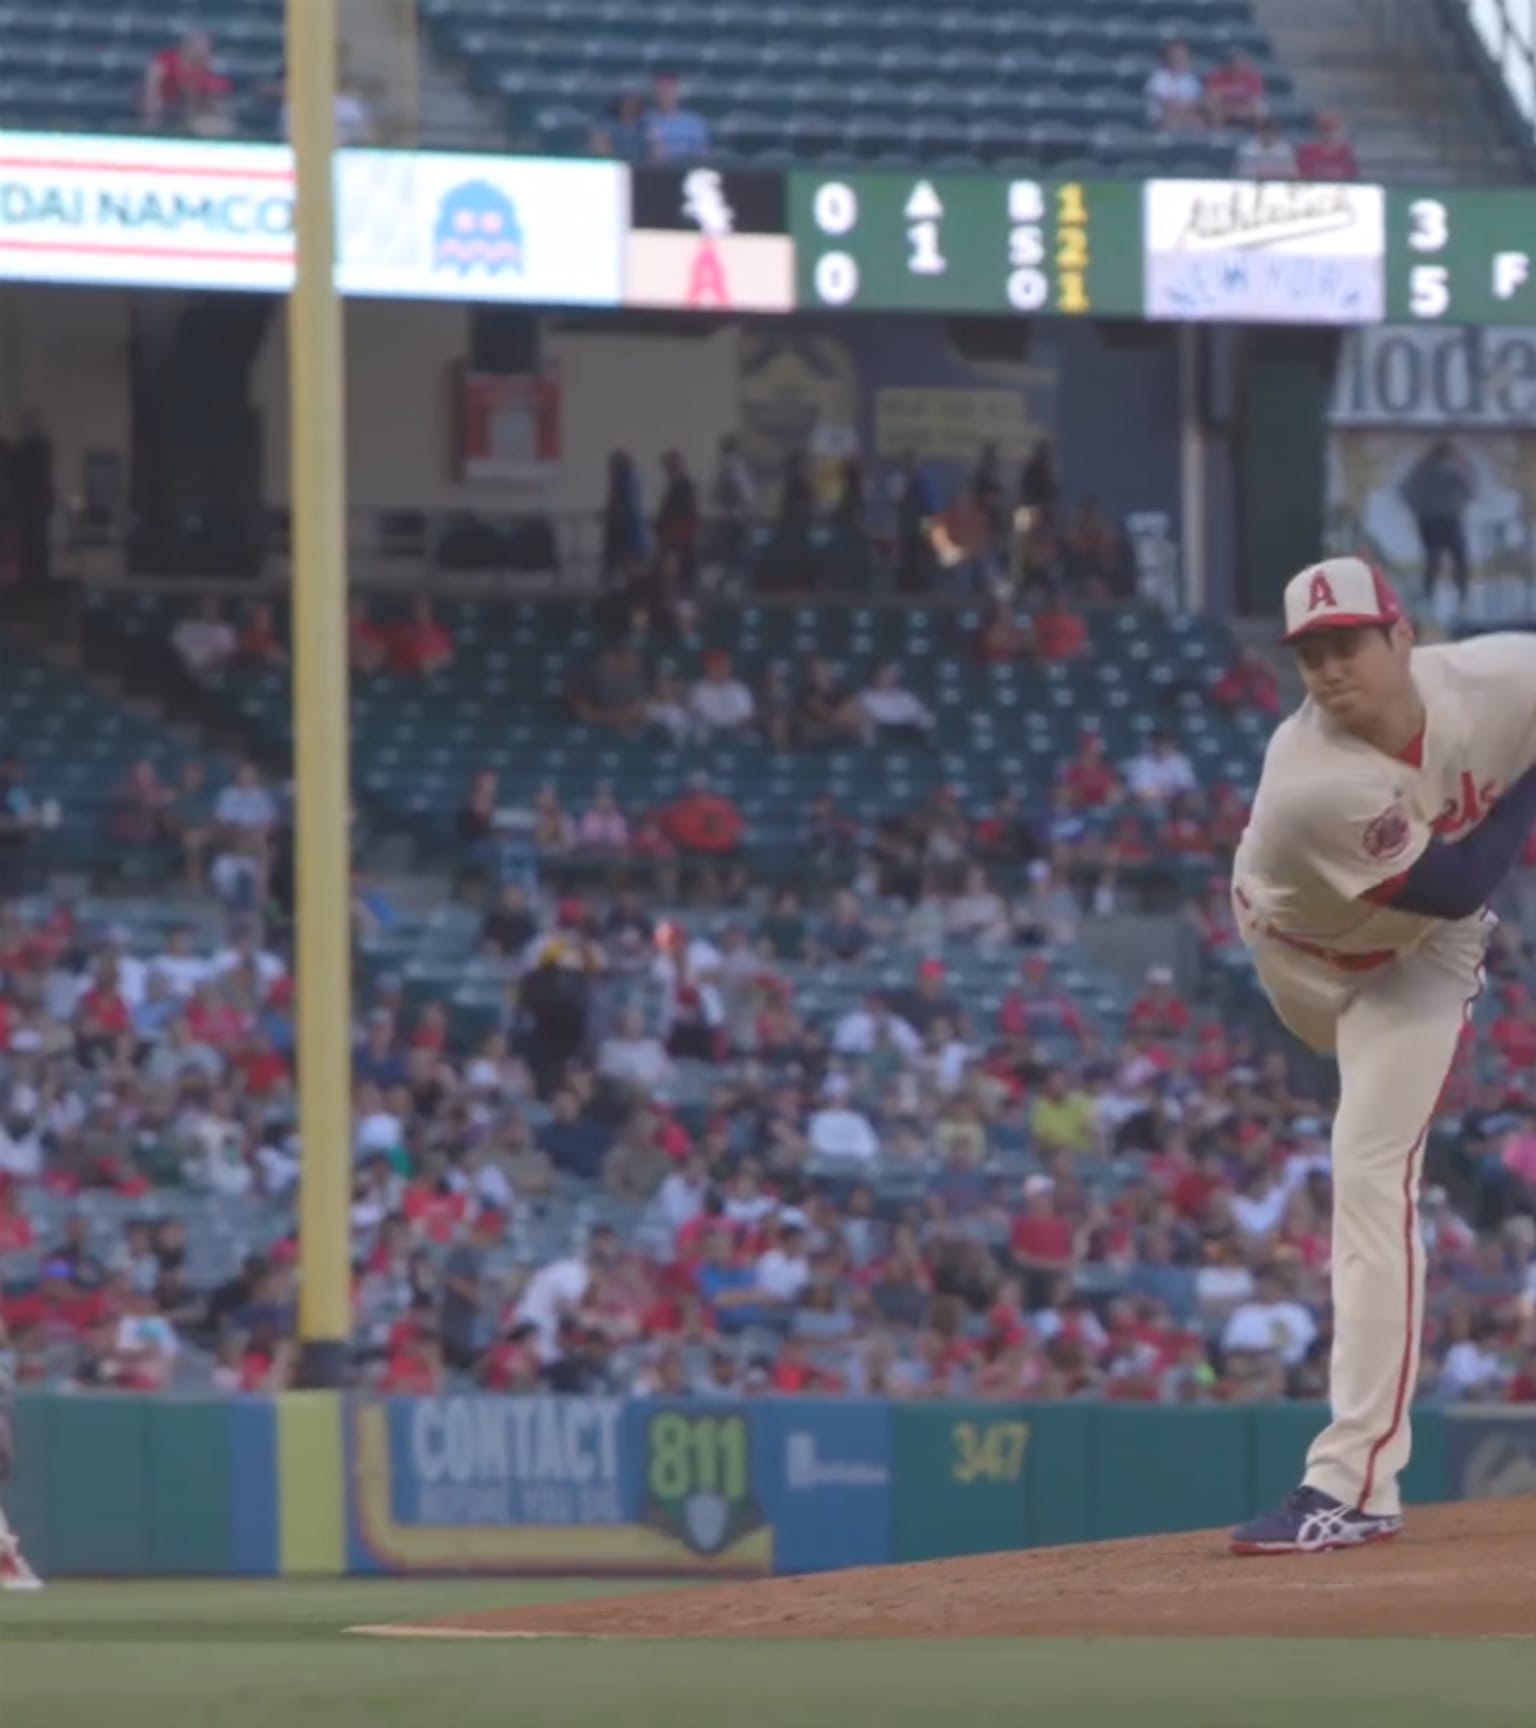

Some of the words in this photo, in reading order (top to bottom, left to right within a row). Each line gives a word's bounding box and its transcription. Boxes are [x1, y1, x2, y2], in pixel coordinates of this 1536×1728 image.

[97, 189, 295, 236] NAMCO
[812, 178, 858, 235] 0
[1408, 199, 1449, 252] 3
[687, 236, 733, 310] A
[907, 222, 947, 275] 1
[1056, 224, 1089, 270] 2
[813, 249, 860, 306] 0
[1056, 269, 1090, 313] 1
[1409, 265, 1450, 319] 5
[1493, 251, 1529, 300] F
[1307, 569, 1337, 612] A
[412, 1399, 622, 1480] CONTACT
[649, 1411, 748, 1500] 811
[951, 1422, 1032, 1483] 347
